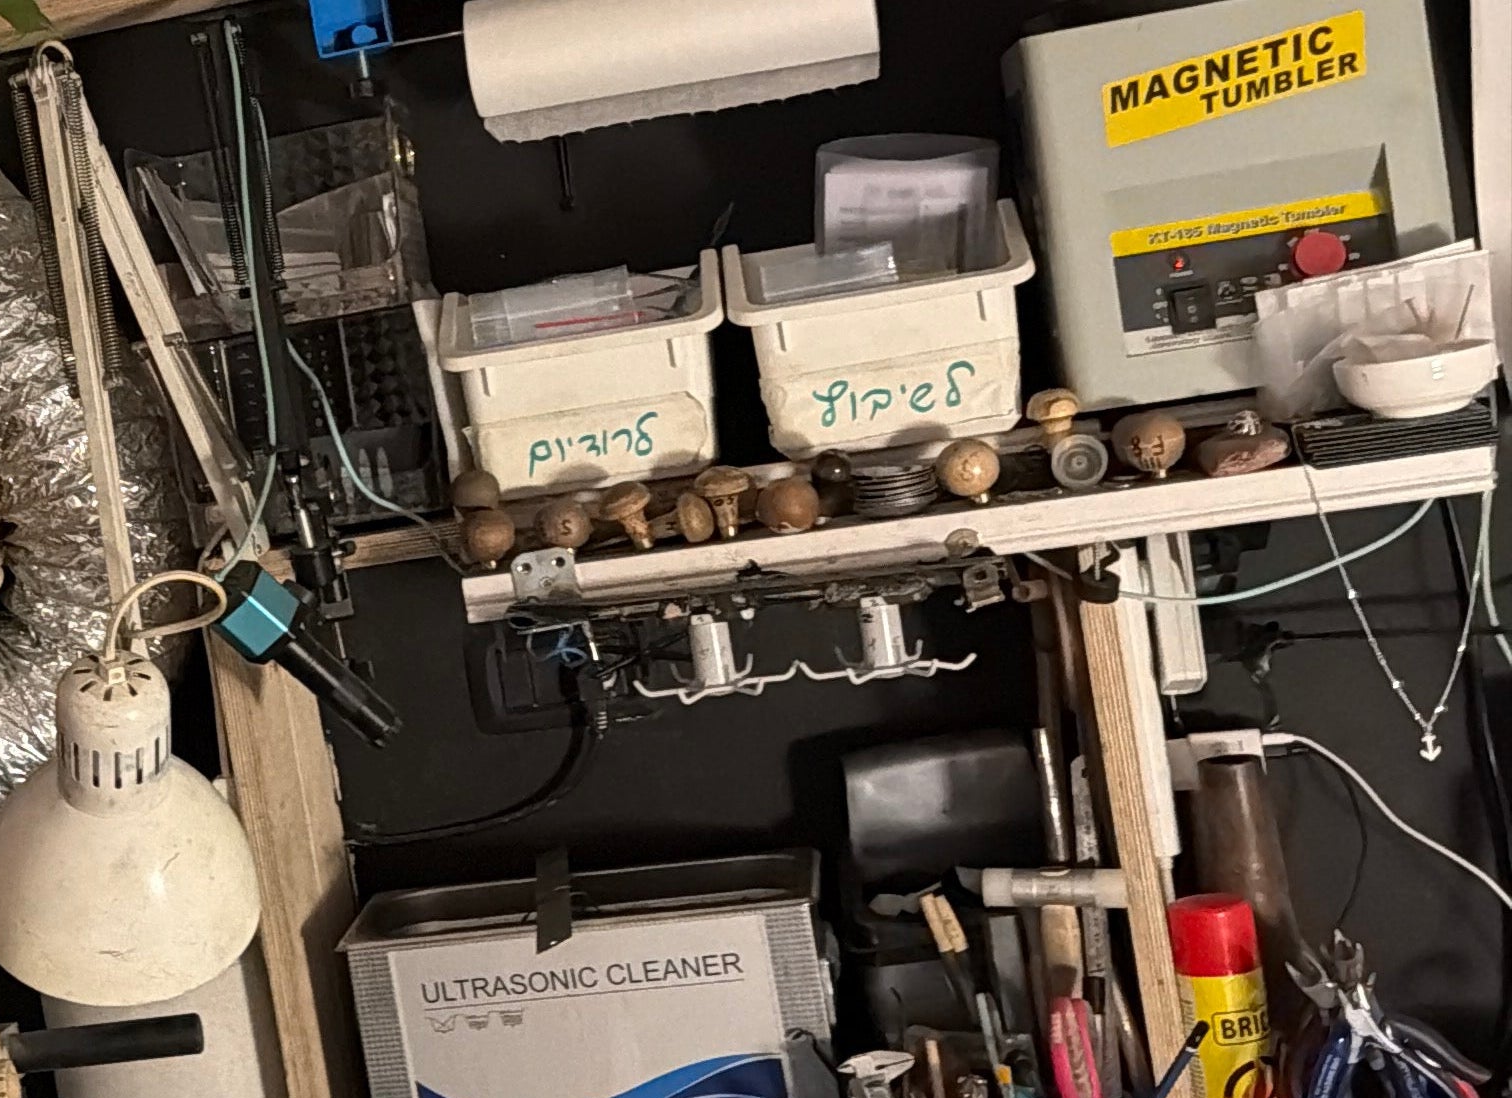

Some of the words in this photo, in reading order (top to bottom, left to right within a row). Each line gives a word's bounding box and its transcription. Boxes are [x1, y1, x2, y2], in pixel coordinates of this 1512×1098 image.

[1110, 25, 1335, 114] MAGNETIC
[1200, 52, 1359, 115] TUMBLER
[1207, 214, 1279, 236] Magnetic
[1281, 204, 1347, 224] Tumbler
[812, 360, 976, 428] לשיבוץ
[528, 411, 658, 478] לרודיום
[421, 966, 598, 1004] ULTRASONIC
[606, 952, 744, 986] CLEANER
